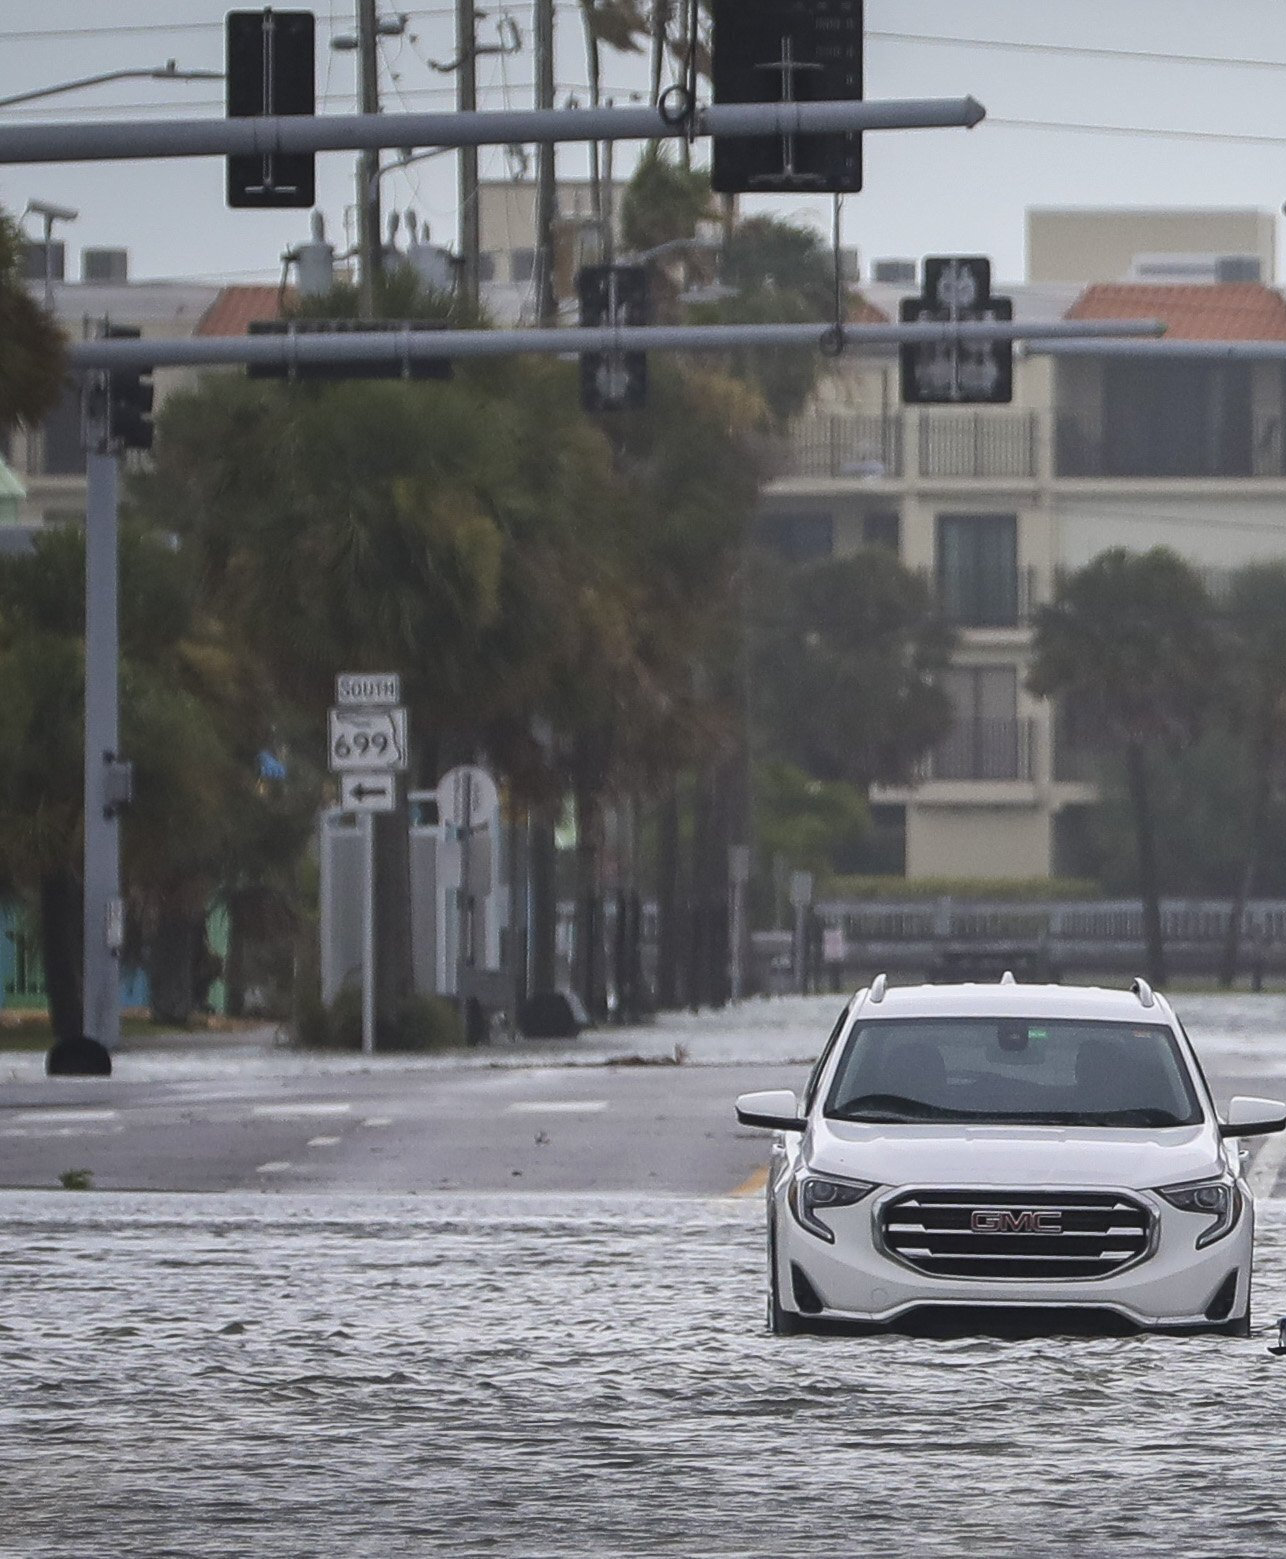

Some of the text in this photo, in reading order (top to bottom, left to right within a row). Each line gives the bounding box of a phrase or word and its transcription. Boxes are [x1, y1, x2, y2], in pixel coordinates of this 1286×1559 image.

[340, 680, 395, 696] SOUTH
[335, 732, 387, 758] 699
[971, 1210, 1063, 1233] GMC
